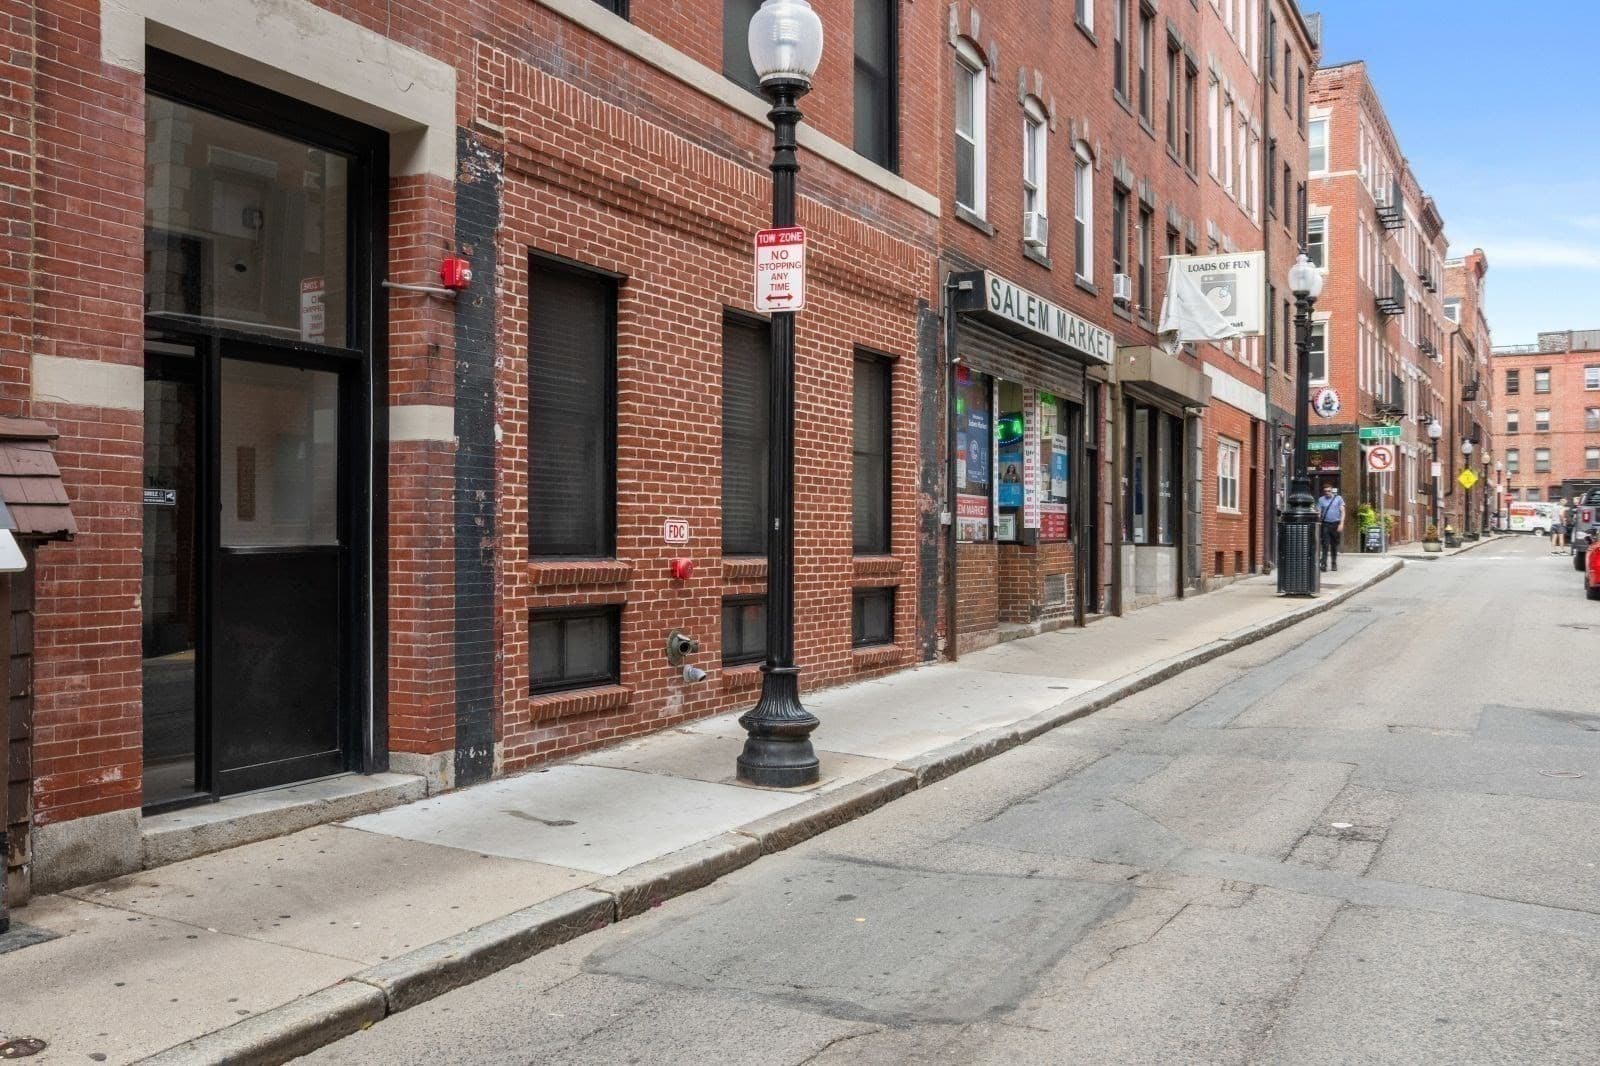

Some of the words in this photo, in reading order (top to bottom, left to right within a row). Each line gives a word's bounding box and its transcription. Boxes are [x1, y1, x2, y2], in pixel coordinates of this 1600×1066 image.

[758, 234, 776, 244] TOW
[779, 232, 803, 242] ZONE
[771, 250, 789, 260] NO
[759, 261, 801, 271] STOPPING
[1187, 262, 1217, 272] LOADS
[1219, 262, 1230, 270] OF
[1233, 261, 1250, 269] FUN
[769, 282, 790, 291] TIME
[991, 278, 1049, 332] SALEM
[1057, 310, 1111, 360] MARKET
[669, 525, 684, 538] FDC
